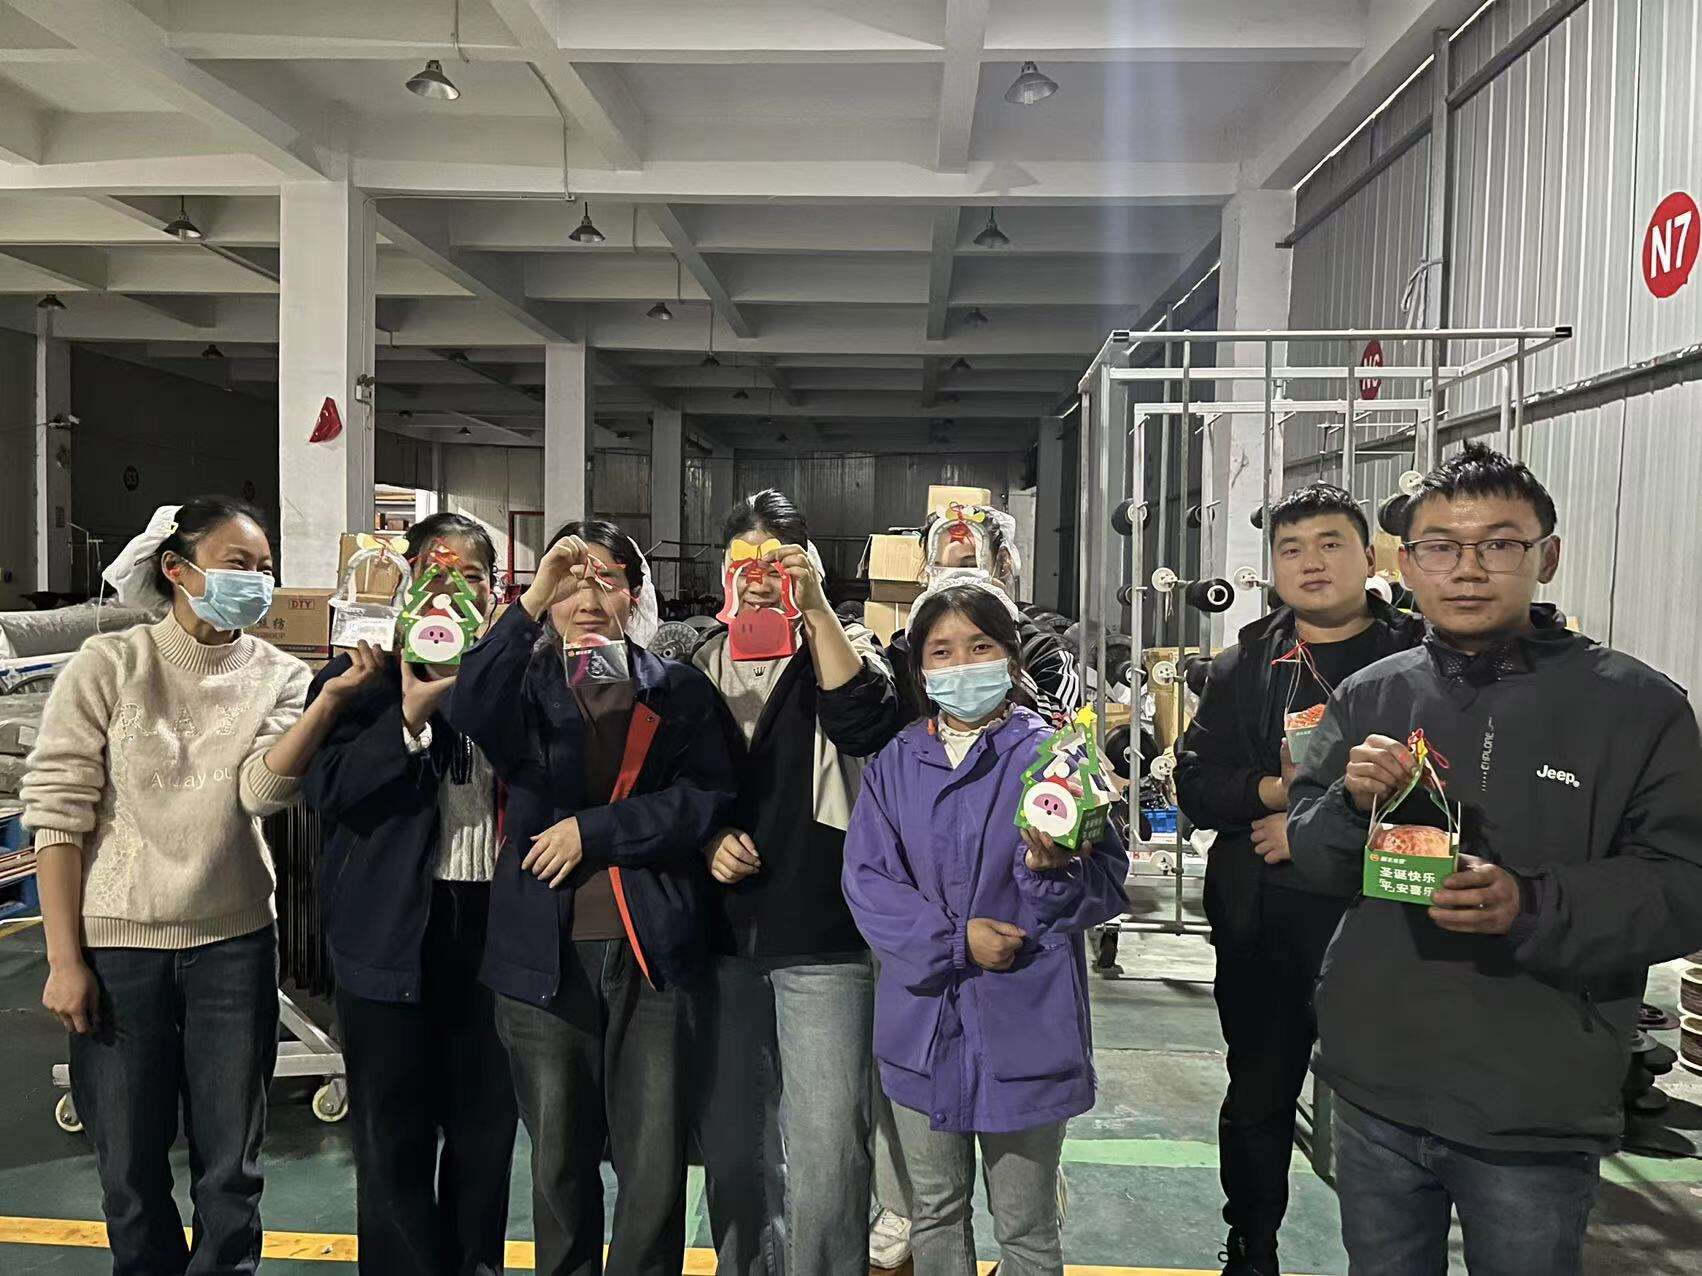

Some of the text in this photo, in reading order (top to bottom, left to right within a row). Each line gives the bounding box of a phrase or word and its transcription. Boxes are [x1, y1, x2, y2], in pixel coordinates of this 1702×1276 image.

[1650, 210, 1692, 279] N7
[291, 599, 313, 609] DTY
[151, 771, 163, 789] A
[1536, 764, 1576, 785] Jeep
[1380, 866, 1436, 884] 圣诞快乐
